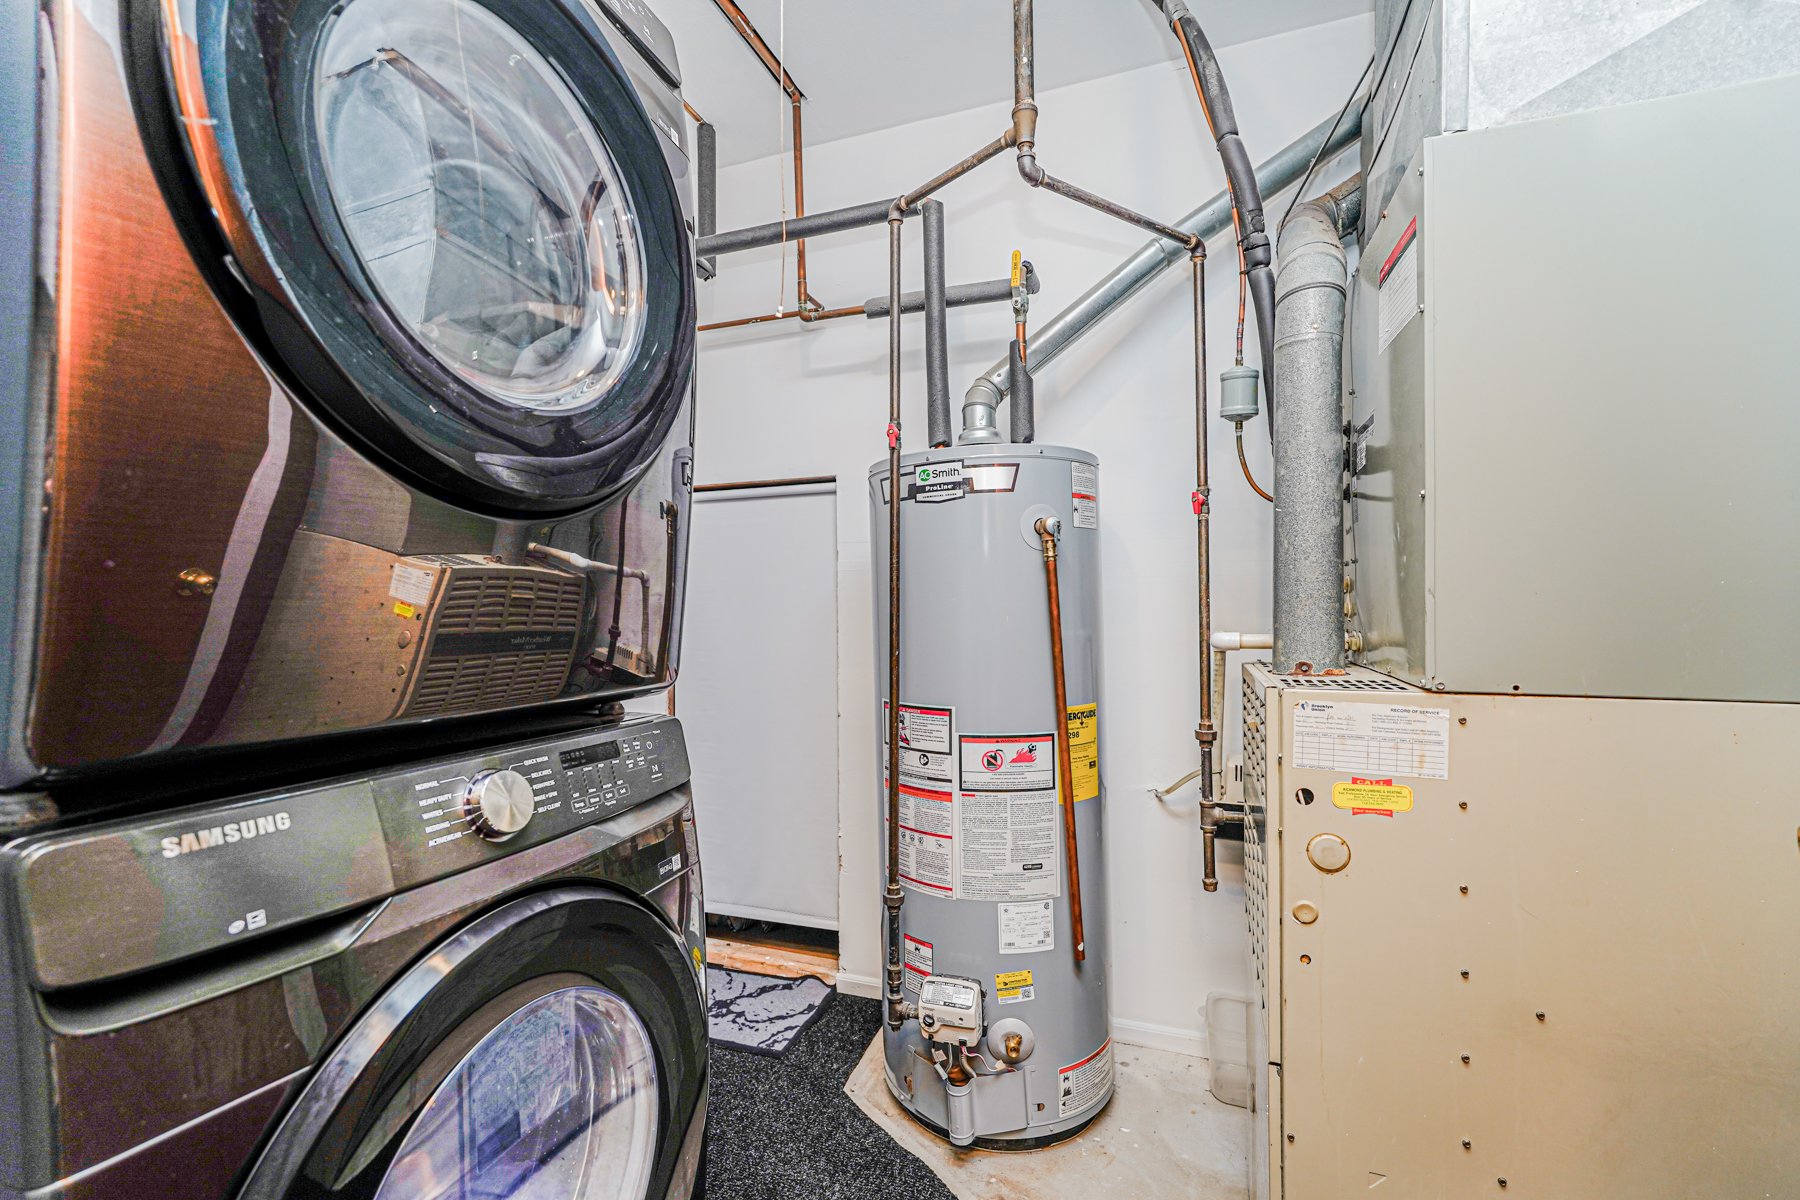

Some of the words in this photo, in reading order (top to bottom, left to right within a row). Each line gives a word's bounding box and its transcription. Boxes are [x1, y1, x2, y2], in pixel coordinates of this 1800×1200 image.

[415, 780, 440, 791] NORMAL
[419, 796, 438, 807] HEAVY
[437, 793, 452, 802] DUTY
[421, 809, 444, 820] WHITES
[425, 821, 450, 834] BEDDING
[161, 812, 291, 858] SAMSUNG
